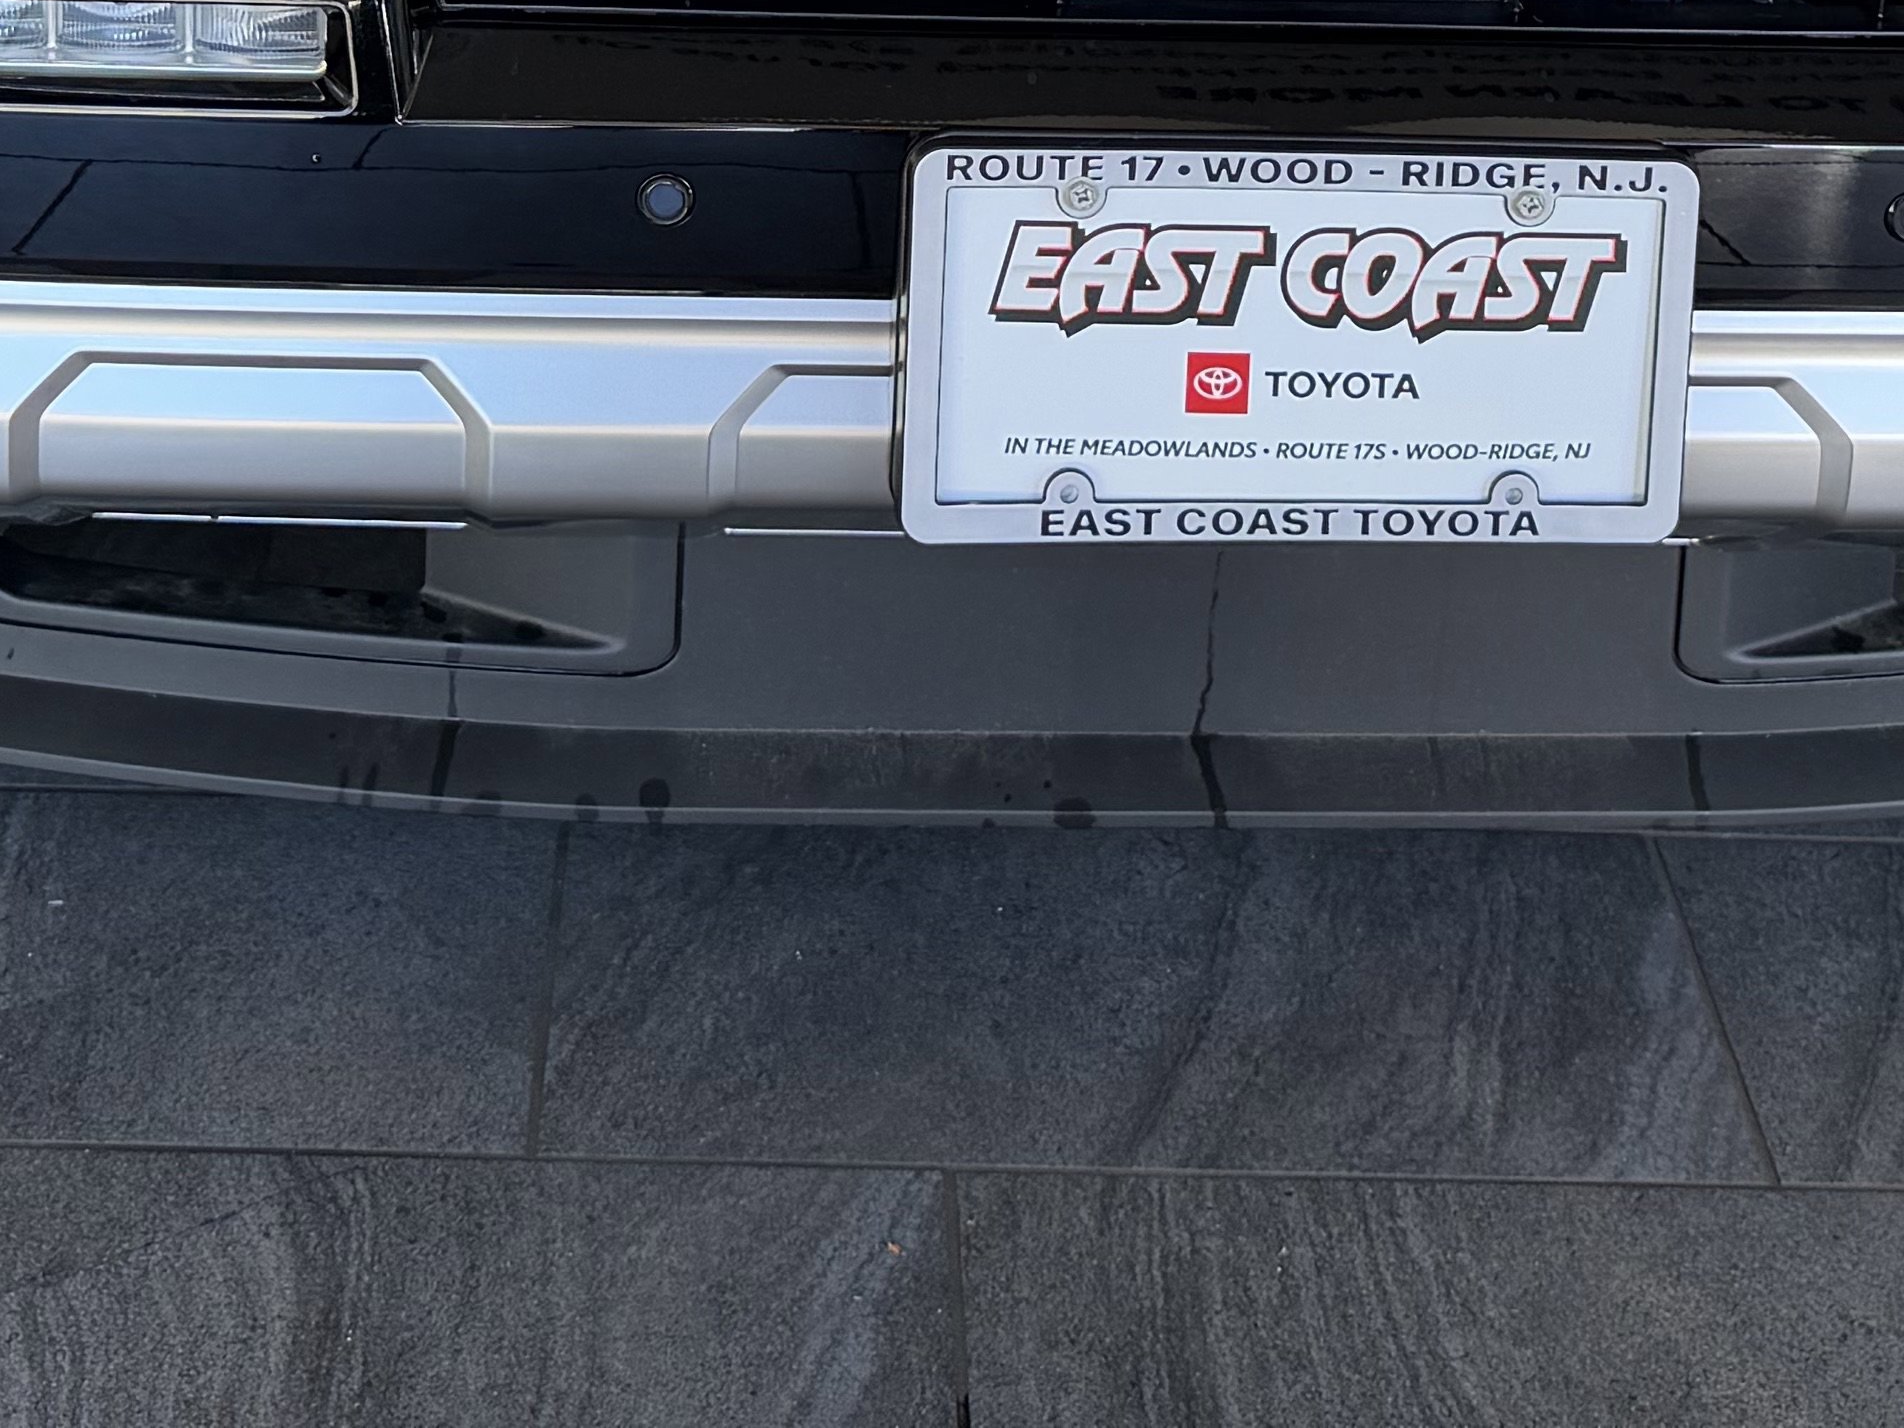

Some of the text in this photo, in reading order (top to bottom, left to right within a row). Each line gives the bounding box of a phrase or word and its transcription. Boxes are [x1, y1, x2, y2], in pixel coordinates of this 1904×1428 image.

[944, 154, 1107, 185] ROUTE
[1119, 155, 1164, 184] 17
[1204, 156, 1354, 189] WOOD
[1400, 159, 1564, 196] RIDGE,
[1577, 161, 1670, 195] N.J.
[988, 219, 1629, 346] EAST COAST
[1263, 370, 1421, 401] TOYOTA
[1003, 436, 1592, 466] IN THE MEADOWLANDS ROUTE 17S WOOD-RIDGE, NJ
[1039, 506, 1541, 539] EAST COAST TOYOTA
